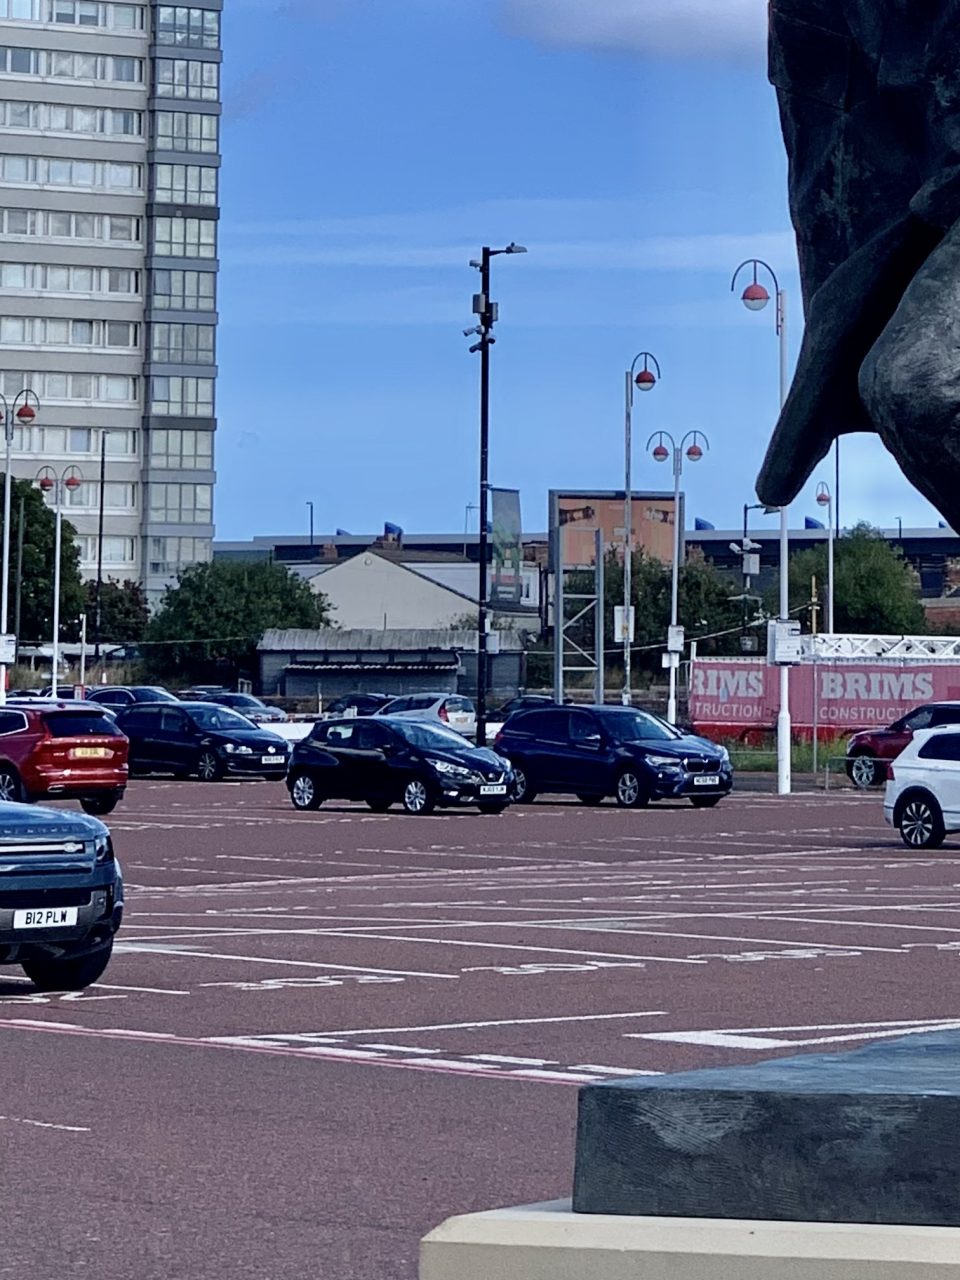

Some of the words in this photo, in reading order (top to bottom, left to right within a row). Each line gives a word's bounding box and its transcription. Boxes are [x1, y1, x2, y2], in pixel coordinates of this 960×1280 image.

[694, 669, 763, 697] RIMS
[821, 672, 934, 700] BRIMS
[695, 703, 761, 718] TRUCTION
[199, 974, 405, 990] 303
[0, 991, 128, 1004] 02
